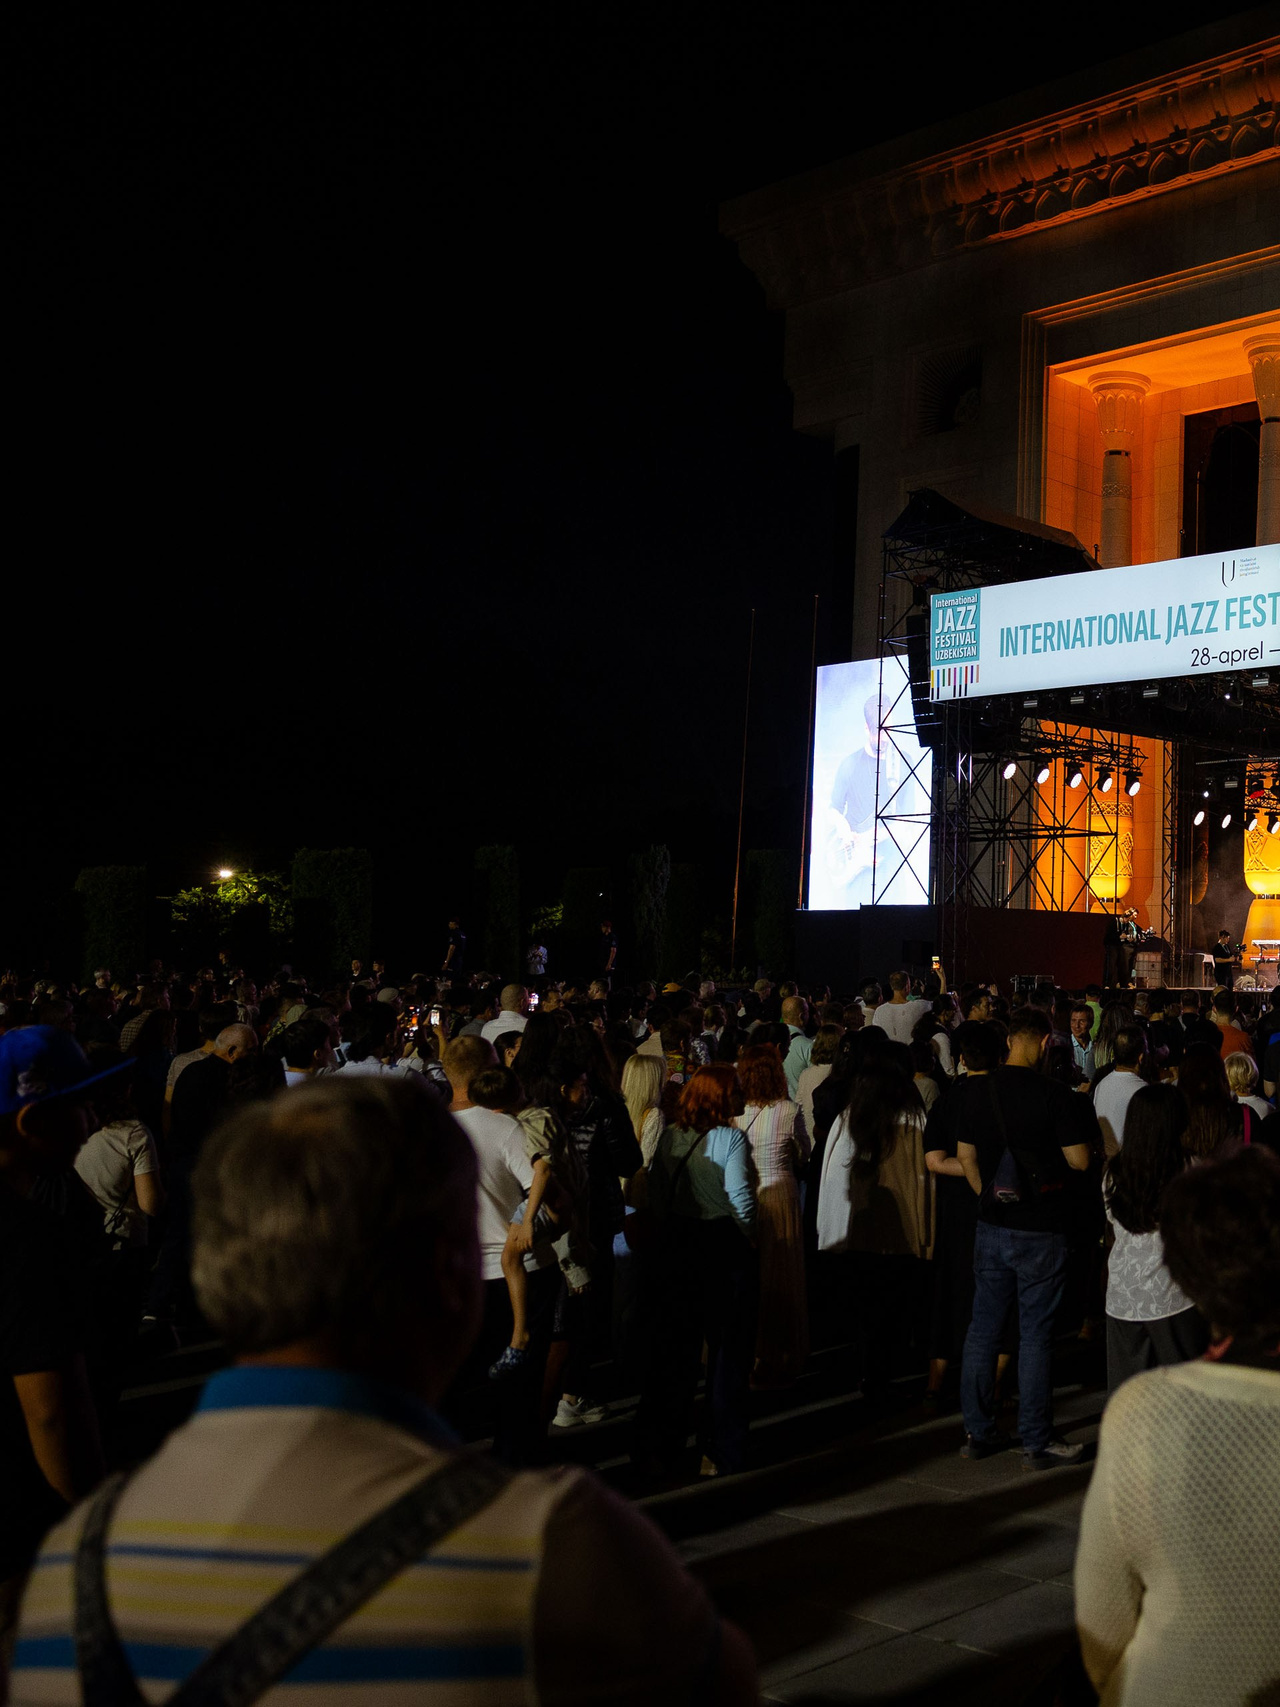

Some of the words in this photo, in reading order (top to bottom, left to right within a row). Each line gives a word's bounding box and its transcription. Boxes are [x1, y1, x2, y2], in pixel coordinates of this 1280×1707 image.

[935, 593, 978, 609] International
[935, 605, 977, 634] JAZZ
[999, 608, 1161, 658] INTERNATIONAL
[1164, 600, 1220, 646] JAZZ
[935, 631, 977, 649] FESTIVAL
[935, 645, 977, 661] UZBEKISTAN
[1190, 640, 1263, 667] 28-aprel
